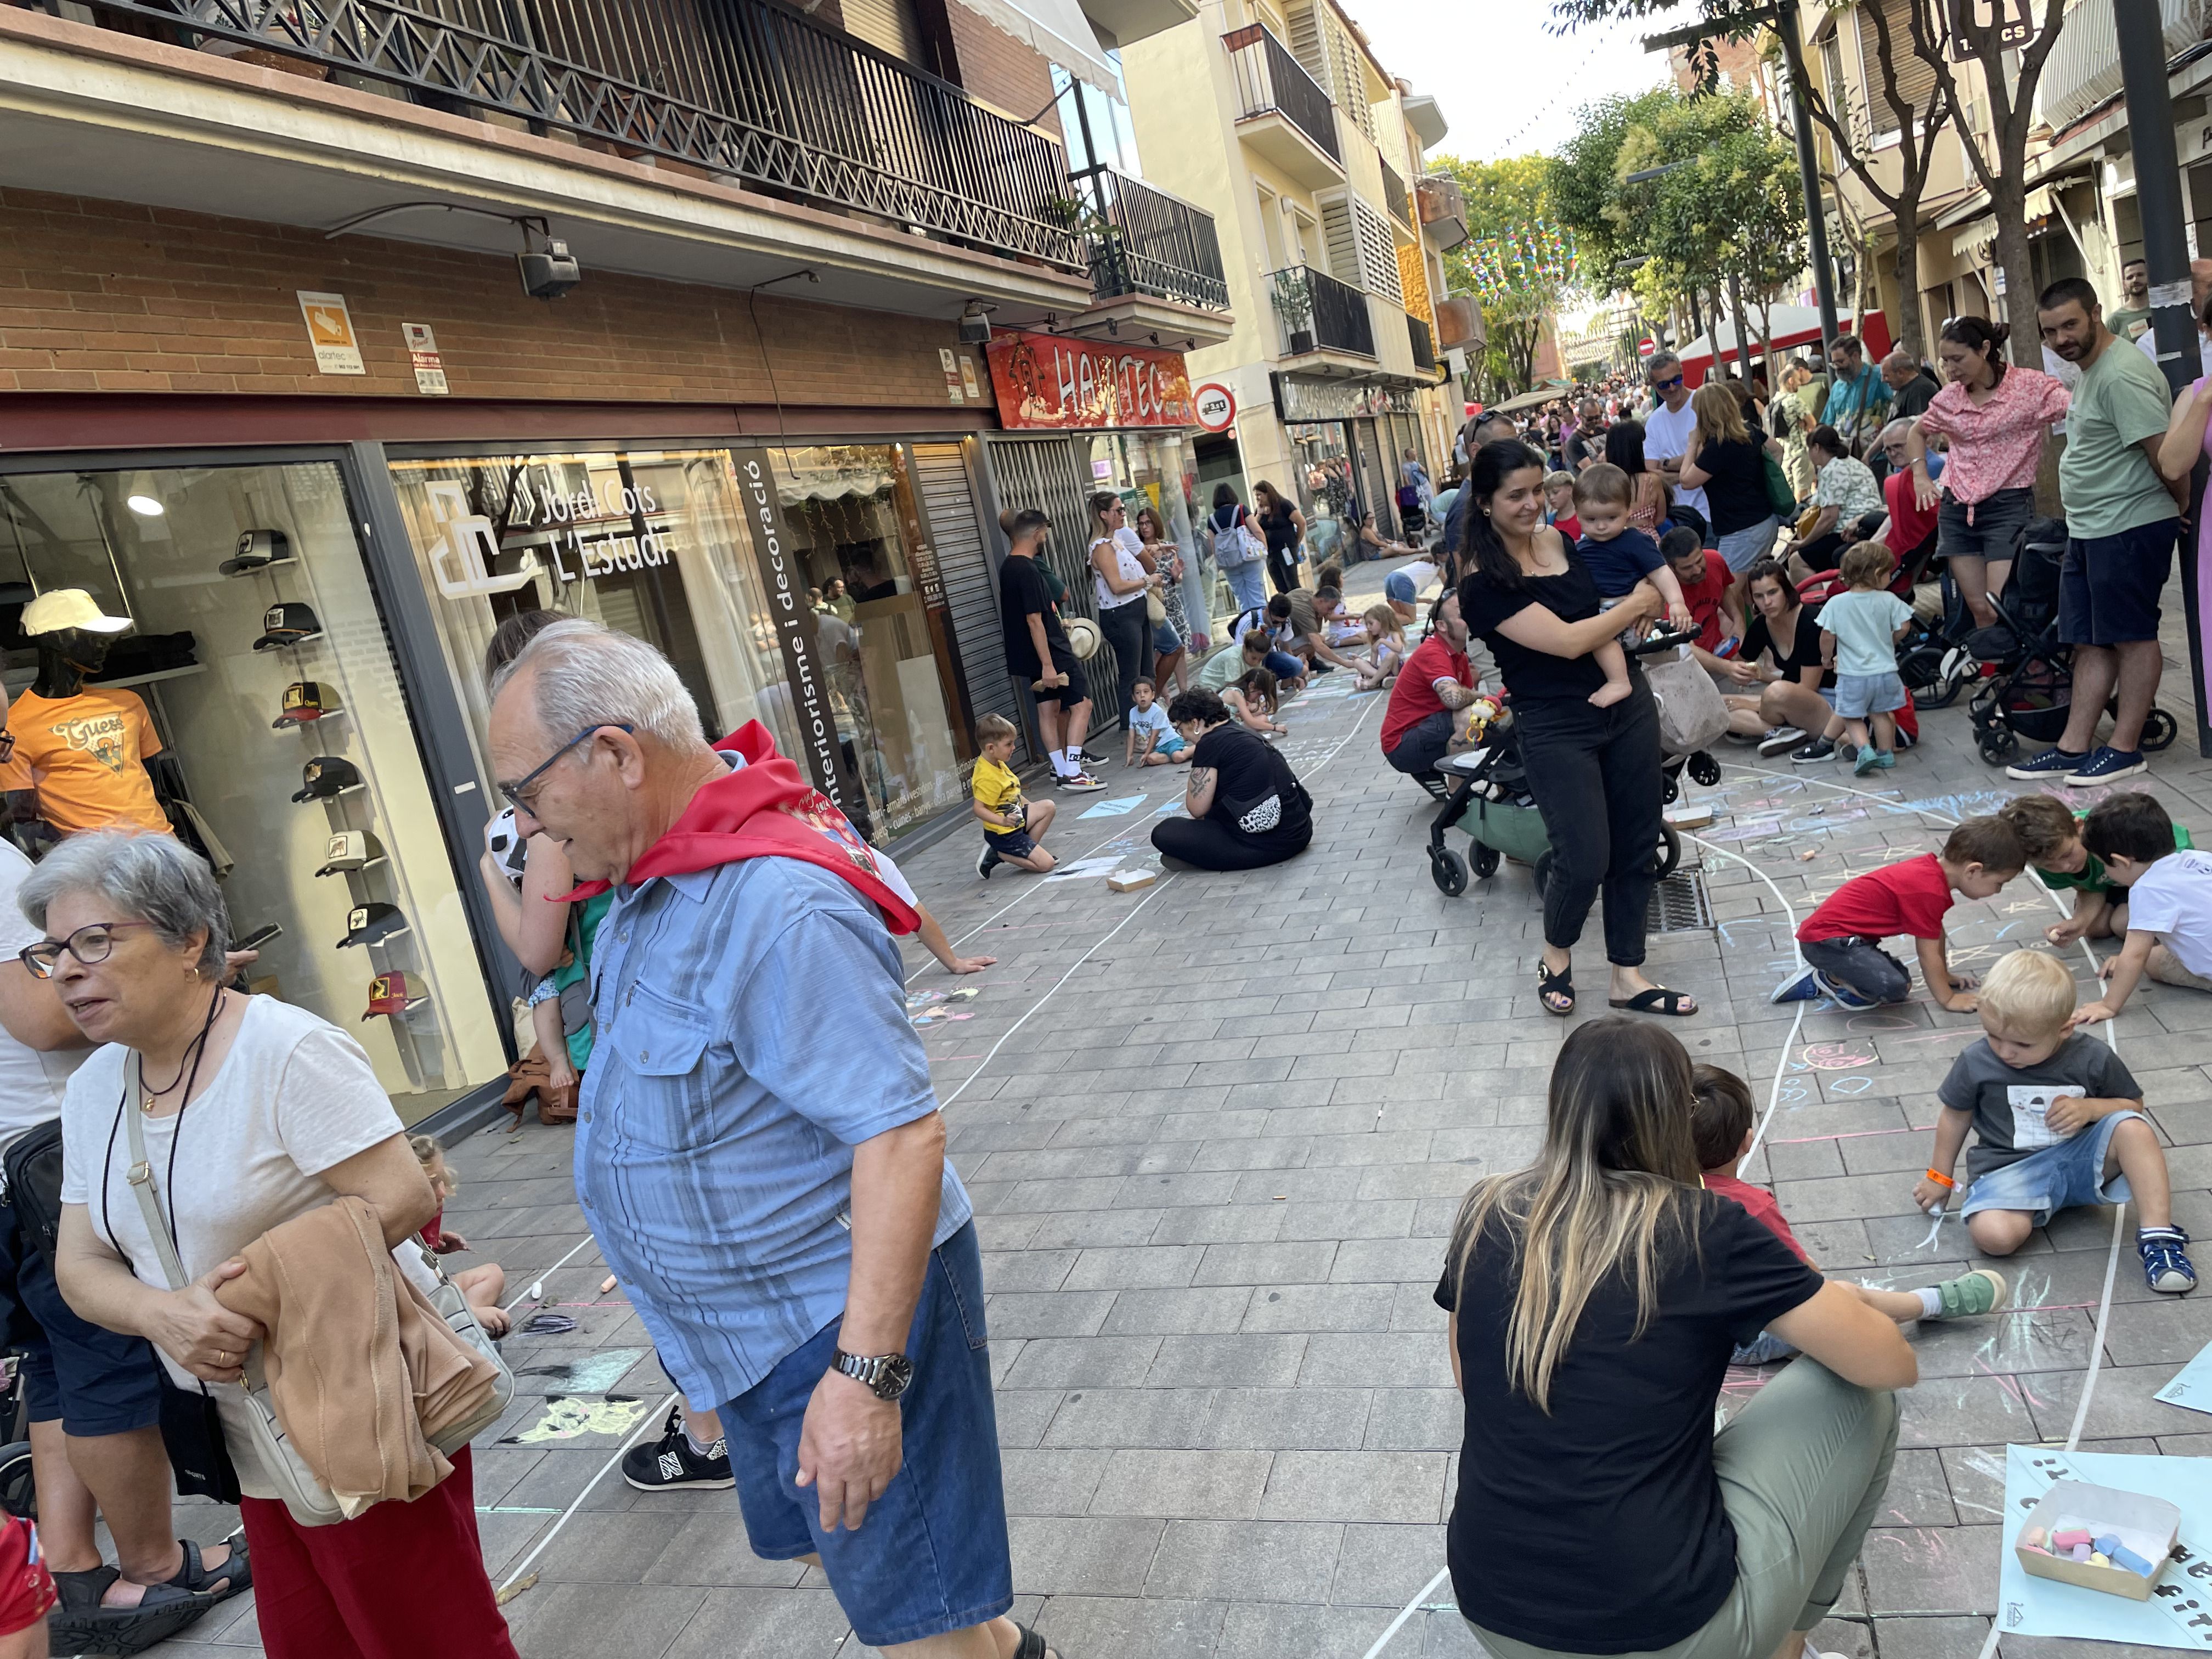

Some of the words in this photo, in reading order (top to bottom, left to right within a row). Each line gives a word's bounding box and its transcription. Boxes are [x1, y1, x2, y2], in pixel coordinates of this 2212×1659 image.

[413, 353, 440, 363] Alarma
[539, 479, 602, 523] Jordi
[603, 479, 656, 516] Cots
[549, 521, 669, 581] L'Estudi
[743, 460, 793, 611] decoració
[784, 619, 798, 628] i
[792, 636, 842, 806] nteriorisme
[815, 799, 831, 814] 2024
[893, 811, 912, 830] cuines
[914, 800, 932, 817] banys
[934, 792, 946, 806] obra
